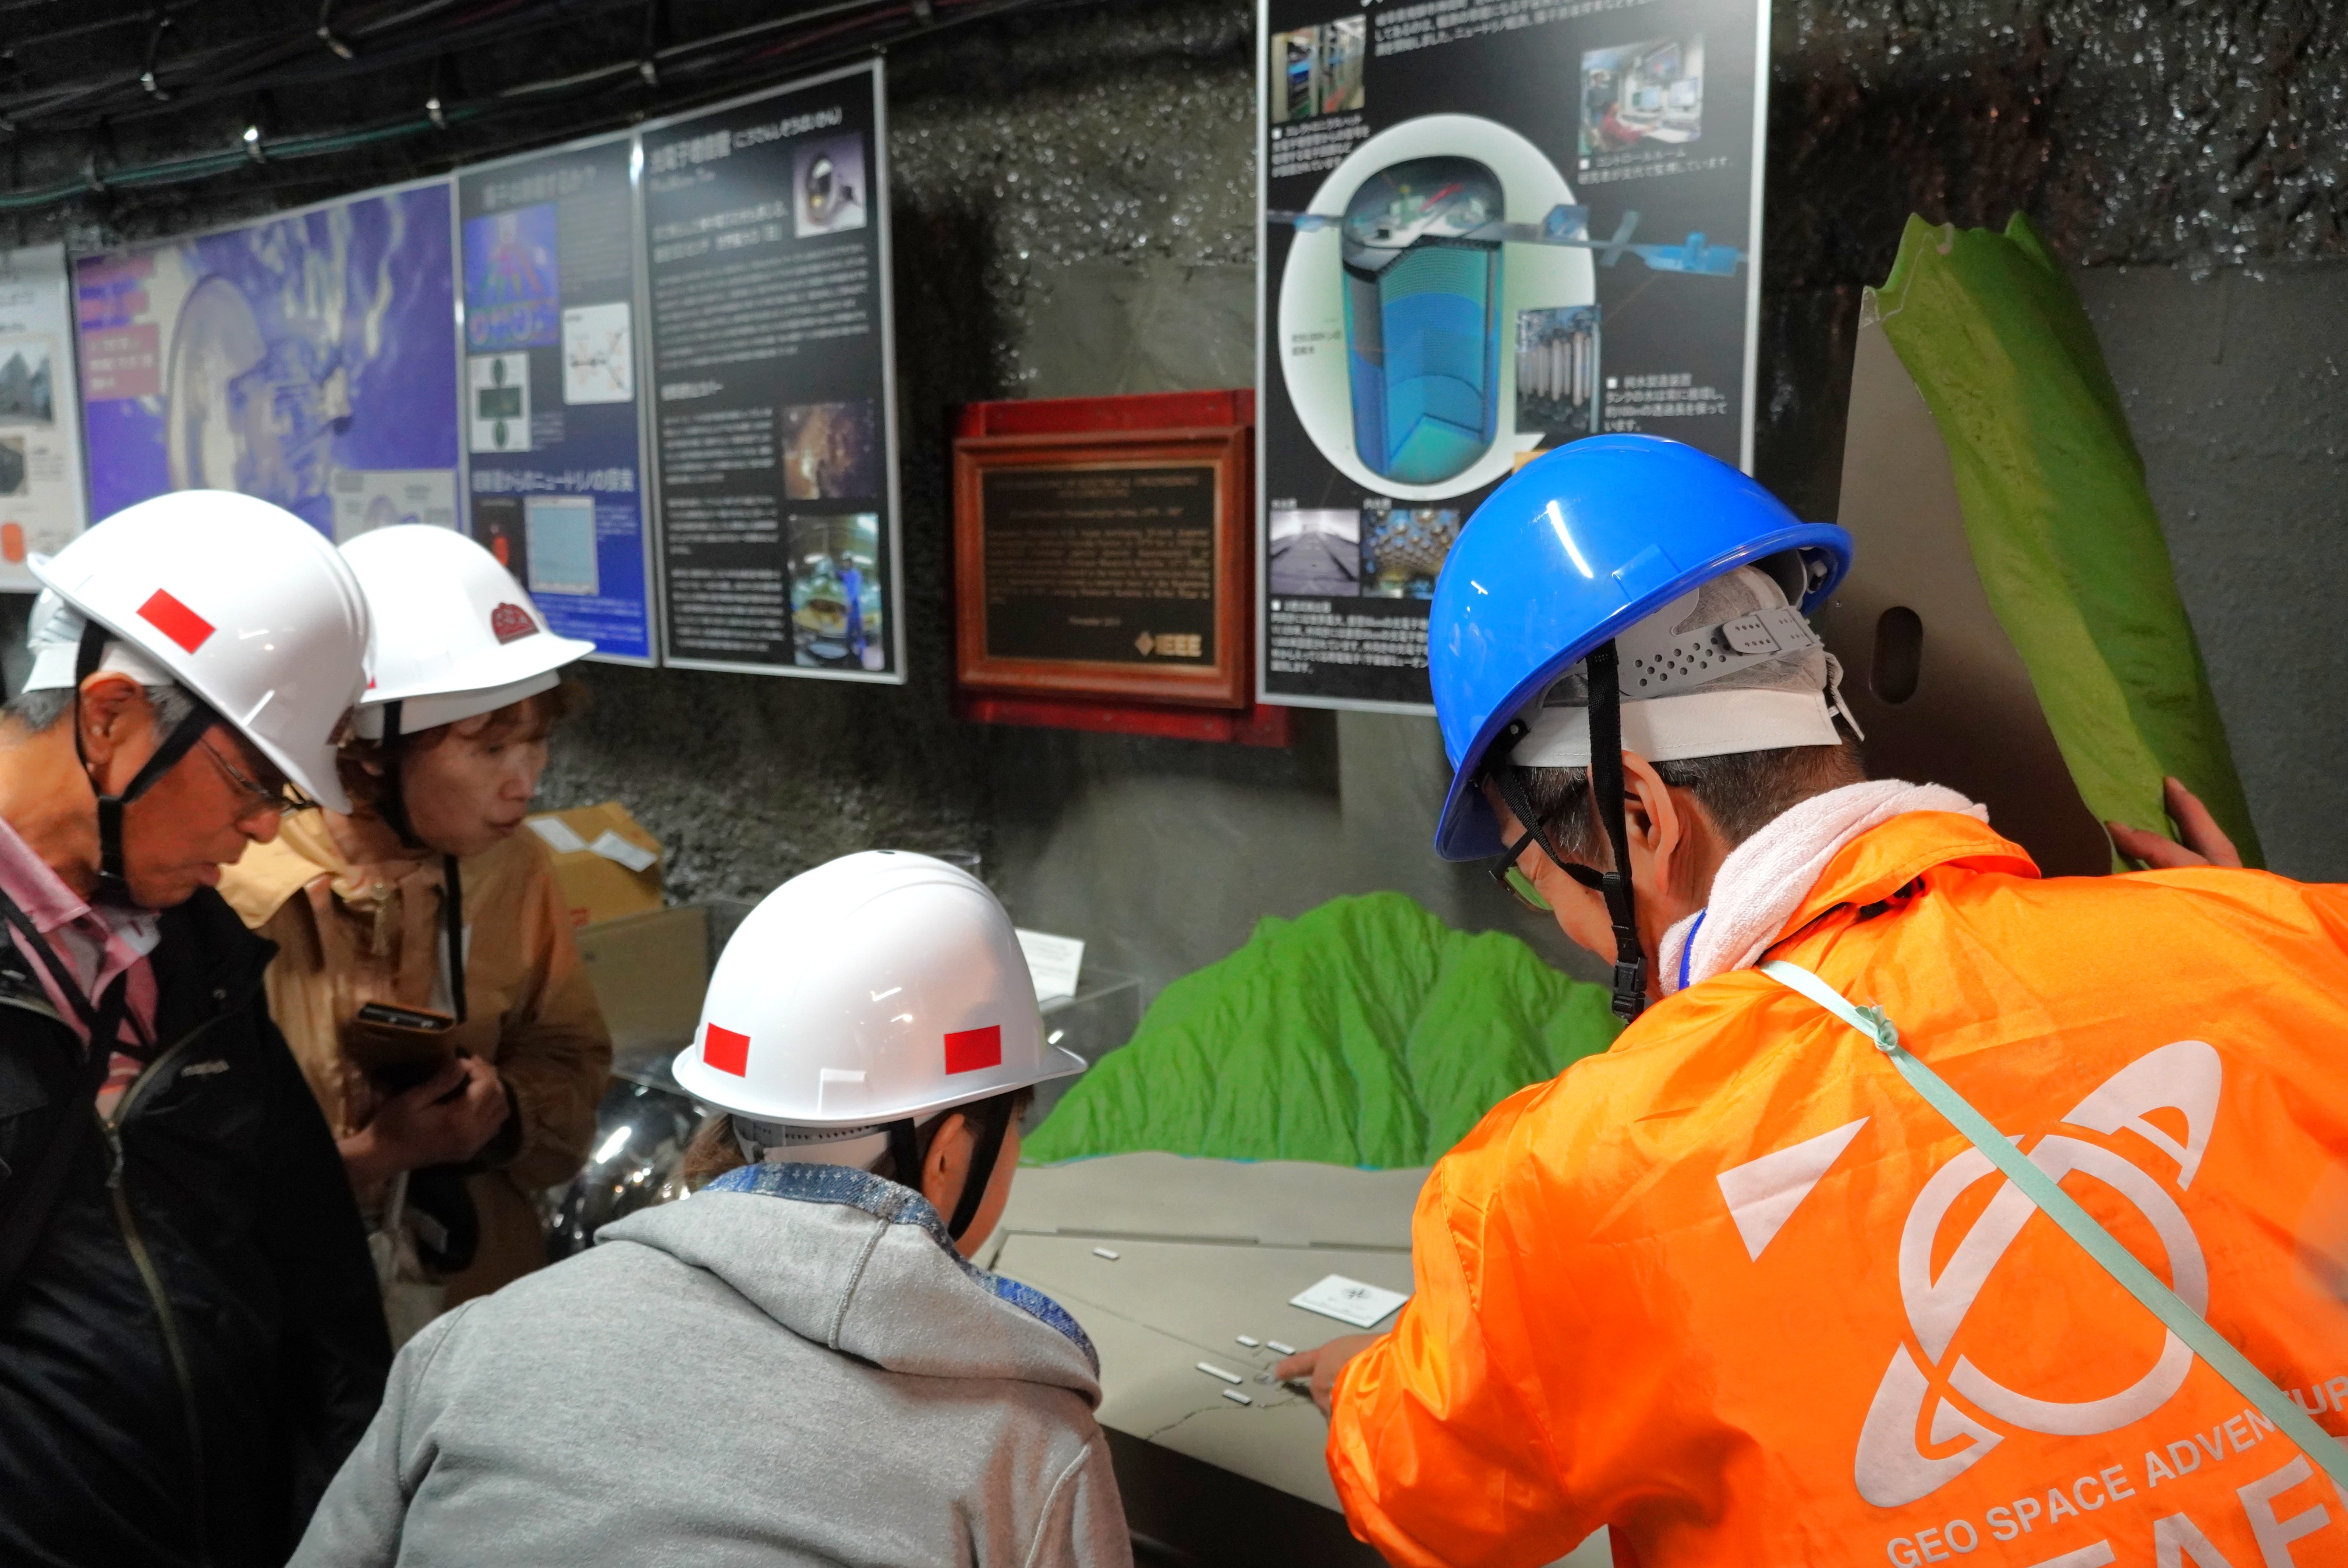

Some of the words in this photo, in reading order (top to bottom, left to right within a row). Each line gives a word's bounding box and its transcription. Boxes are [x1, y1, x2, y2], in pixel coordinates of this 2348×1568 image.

[1155, 634, 1202, 657] IEEE
[1887, 1519, 1978, 1568] GEO
[1986, 1464, 2135, 1541] SPACE
[2145, 1375, 2348, 1487] ADVENUR
